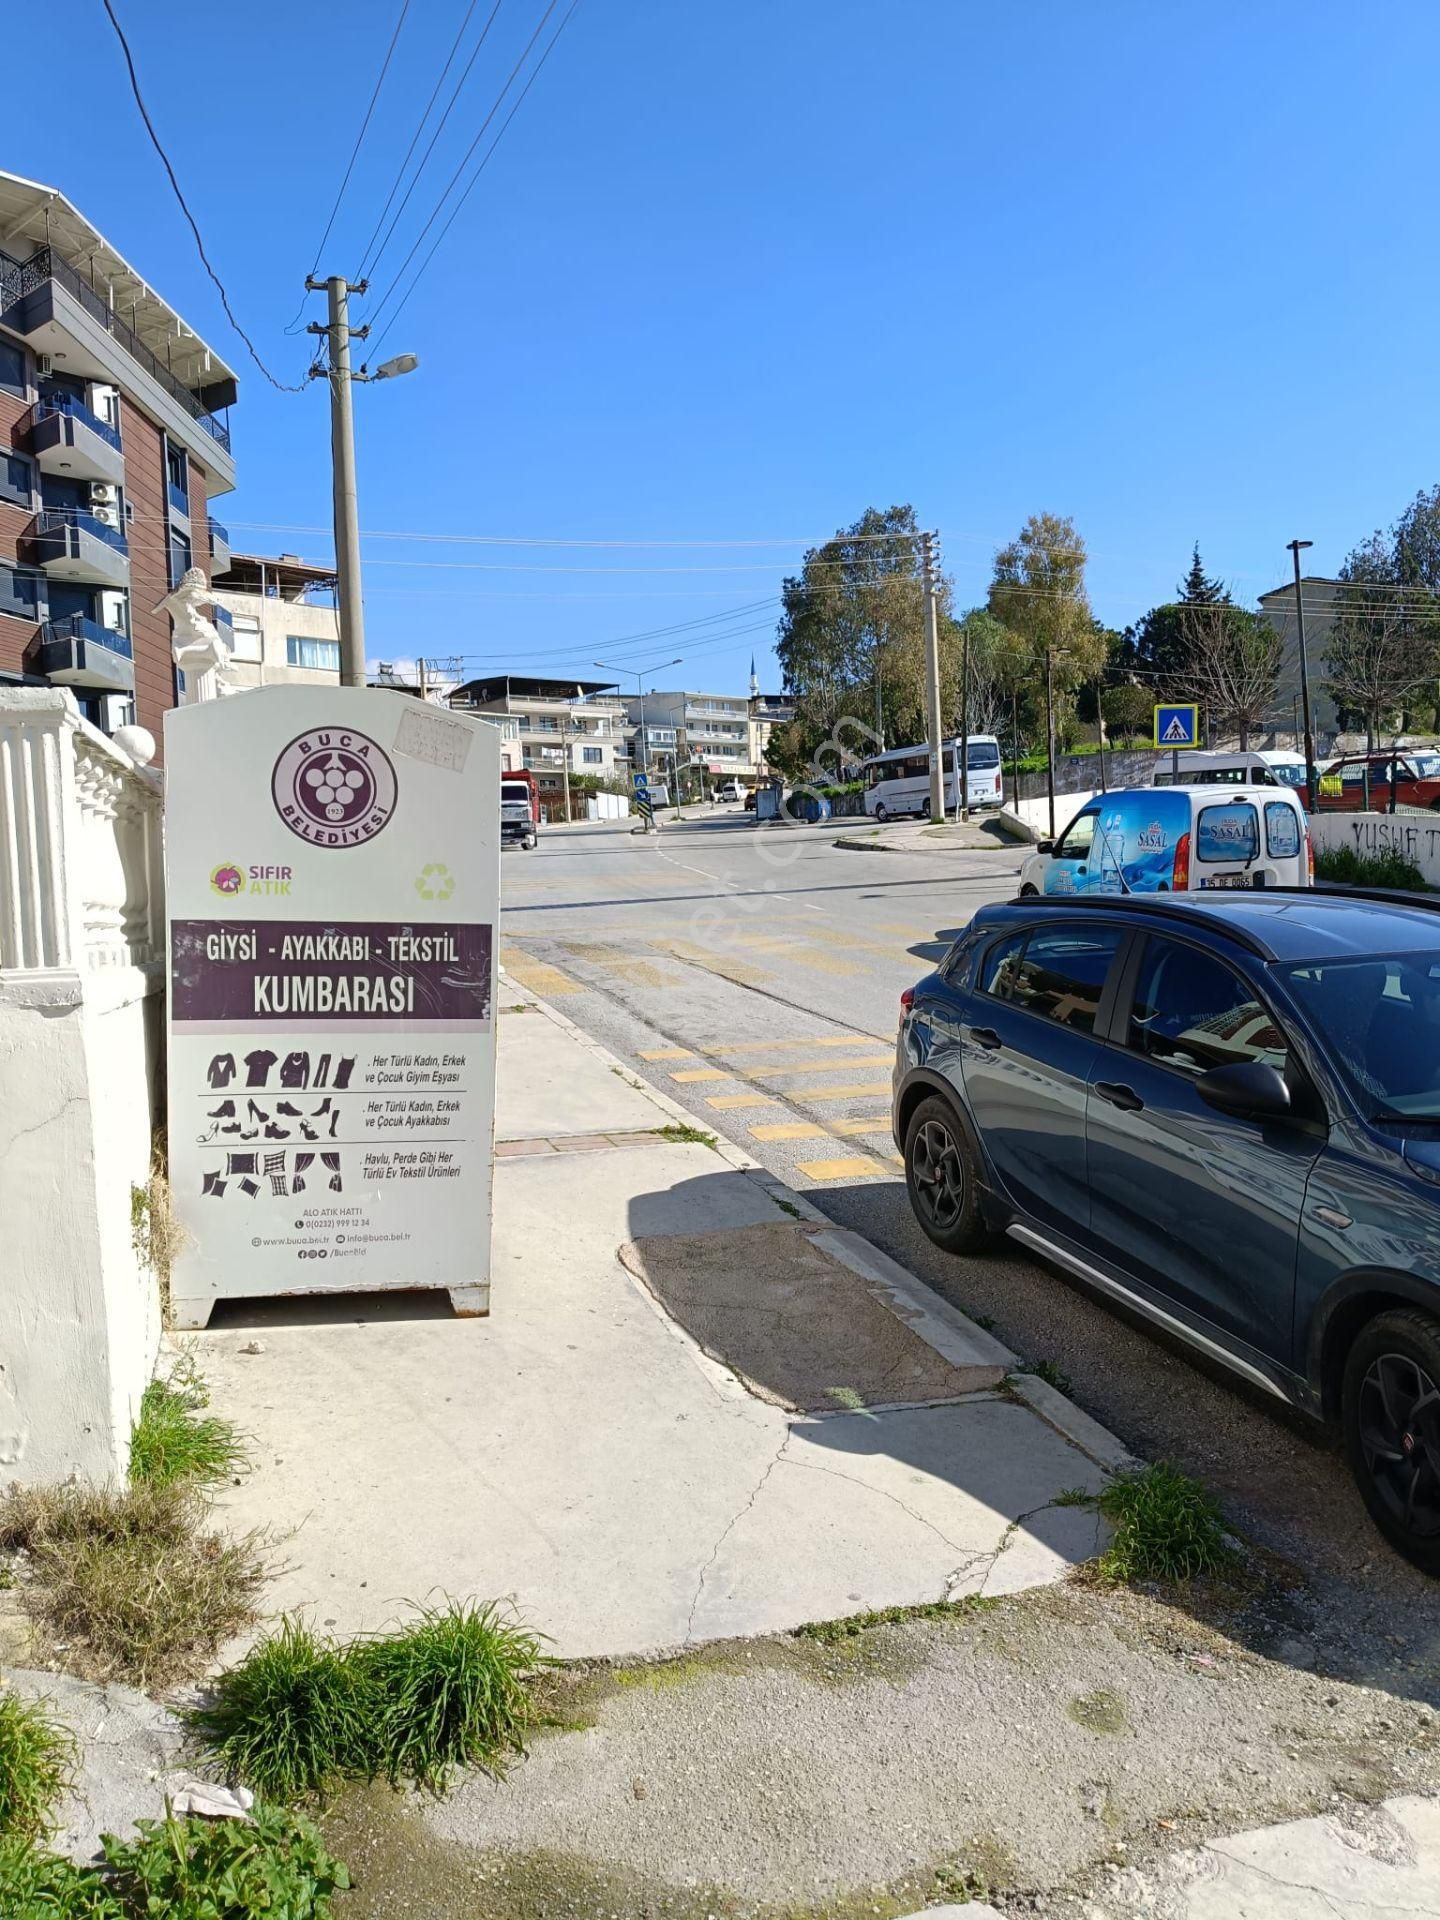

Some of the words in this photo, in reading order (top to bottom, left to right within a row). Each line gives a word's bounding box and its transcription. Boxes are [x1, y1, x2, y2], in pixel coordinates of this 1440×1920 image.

[298, 733, 370, 758] BUCA
[327, 808, 344, 816] 1923
[282, 805, 388, 844] BELEDİYESİ
[1210, 825, 1248, 839] SASAL
[1137, 831, 1168, 848] SASAL
[1352, 822, 1418, 854] YUSUF
[249, 865, 292, 880] SIFIR
[250, 881, 292, 896] ATIK
[206, 928, 257, 961] GİYSİ
[281, 935, 370, 961] AYAKKABI
[387, 931, 460, 962] TEKSTİL
[254, 975, 414, 1013] KUMBARASI
[372, 1055, 389, 1067] Her
[391, 1055, 412, 1067] Türlü
[413, 1055, 440, 1068] Kadın,
[442, 1055, 466, 1066] Erkek
[365, 1073, 375, 1083] ve
[377, 1071, 404, 1085] Çocuk
[406, 1071, 431, 1085] Giyim
[432, 1071, 460, 1085] Eşyası
[367, 1101, 383, 1112] Her
[385, 1101, 407, 1112] Türlü
[408, 1101, 435, 1113] Kadın,
[437, 1100, 461, 1112] Erkek
[365, 1118, 375, 1127] ve
[377, 1115, 404, 1129] Çocuk
[405, 1115, 451, 1129] Ayakkabısı
[365, 1152, 391, 1165] Havlu,
[393, 1152, 417, 1164] Perde
[419, 1152, 437, 1163] Gibi
[438, 1152, 454, 1163] Her
[363, 1167, 385, 1179] Türlü
[386, 1167, 397, 1179] Ev
[400, 1166, 426, 1178] Tekstil
[428, 1163, 461, 1178] Ürünleri
[303, 1209, 319, 1217] ALO
[320, 1208, 339, 1216] ATIK
[339, 1208, 363, 1216] HATTI
